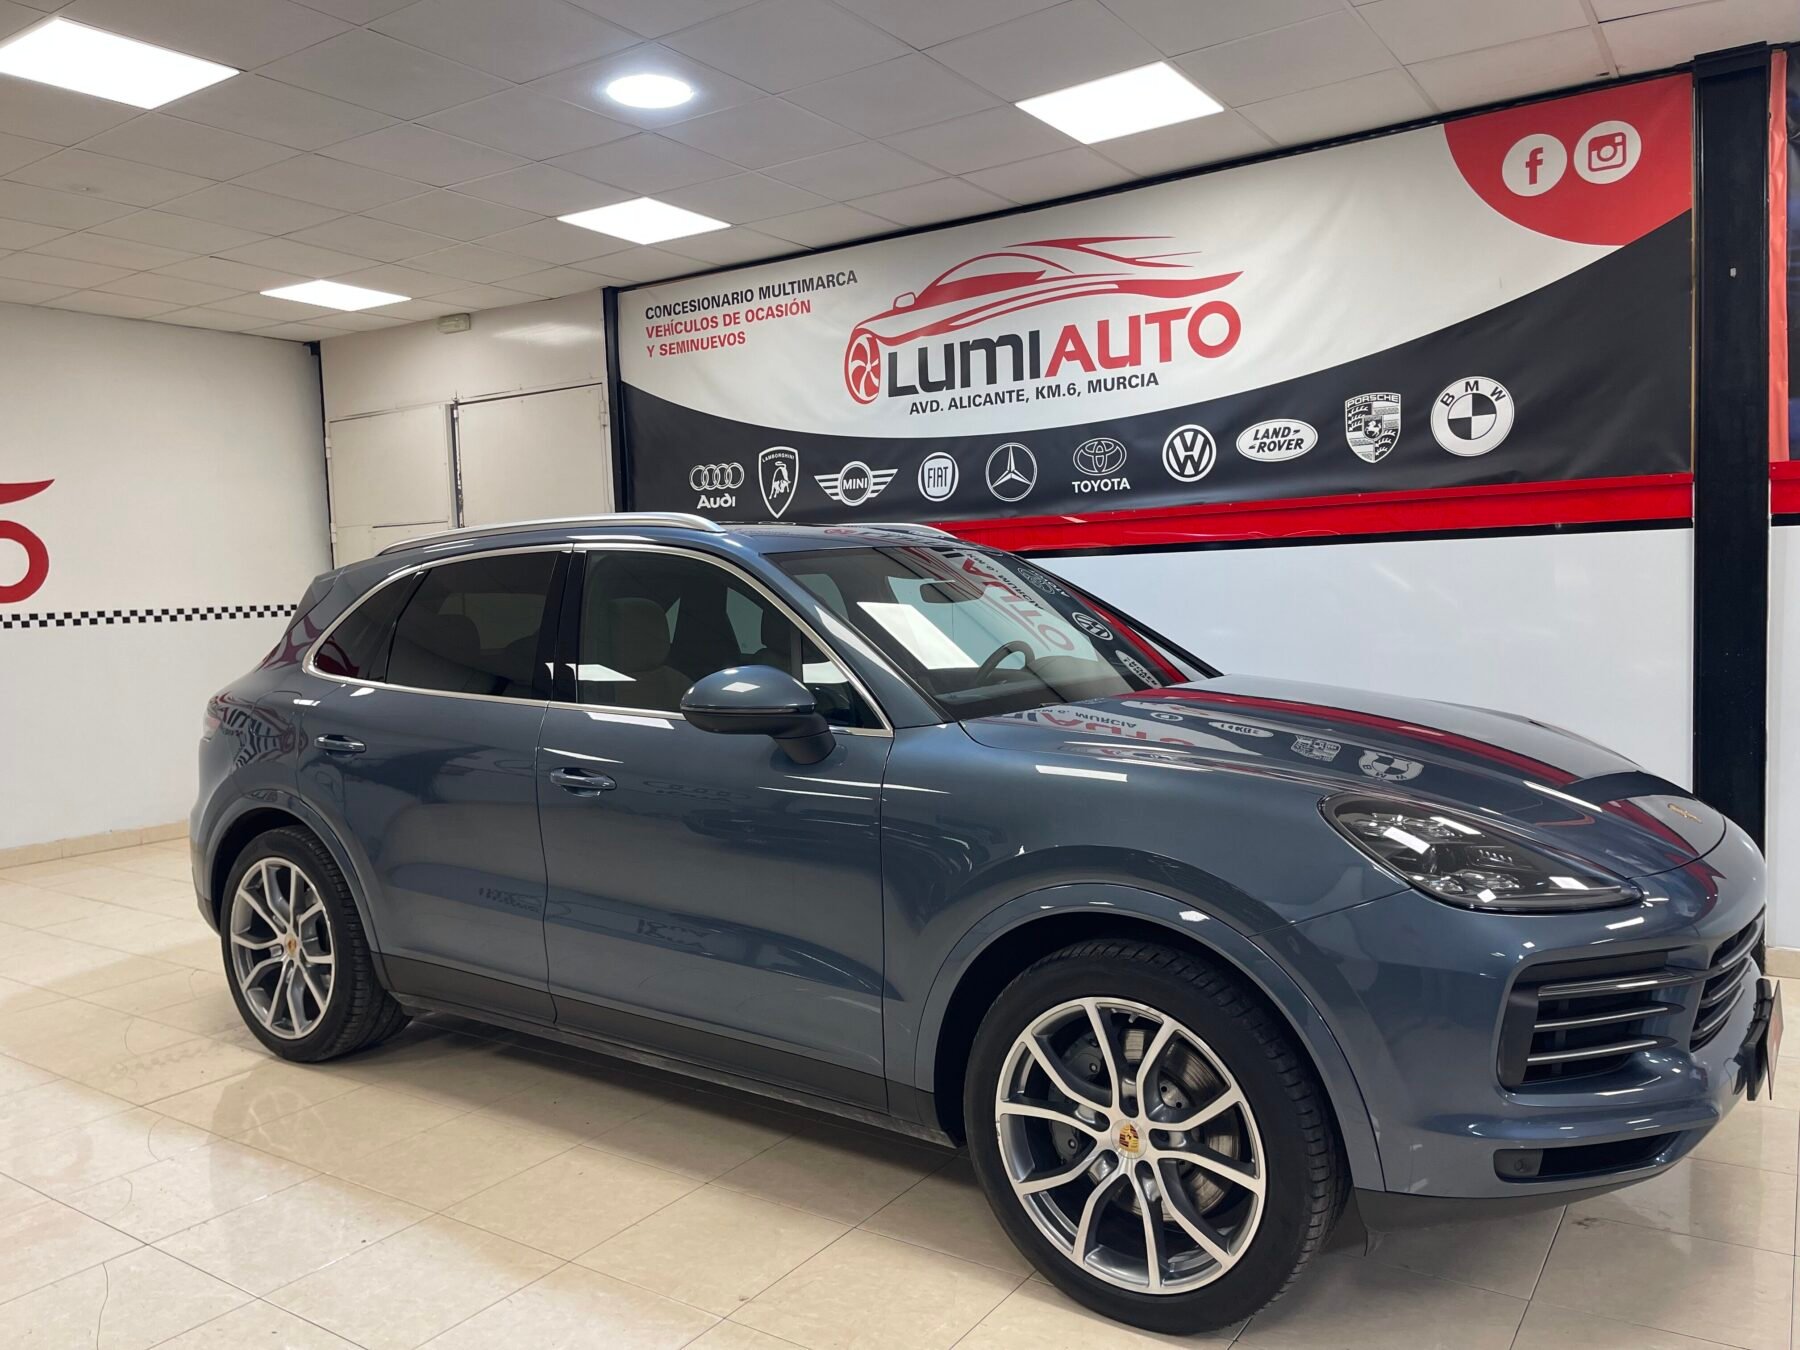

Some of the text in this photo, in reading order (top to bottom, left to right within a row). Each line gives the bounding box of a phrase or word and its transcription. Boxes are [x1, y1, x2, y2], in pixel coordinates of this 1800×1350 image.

[645, 269, 858, 320] CONCESIONARIO MULTIMARCA
[645, 298, 811, 339] VEHÍCULOS DE OCASIÓN
[647, 331, 746, 358] Y SEMINUEVOS
[909, 372, 1159, 415] AVD. ALICANTE, KM.6, MURCIA
[1347, 393, 1399, 408] PORSCHE
[843, 478, 868, 490] MINI
[927, 466, 949, 488] FIAT
[1072, 477, 1131, 493] TOYOTA
[696, 493, 736, 510] Audi
